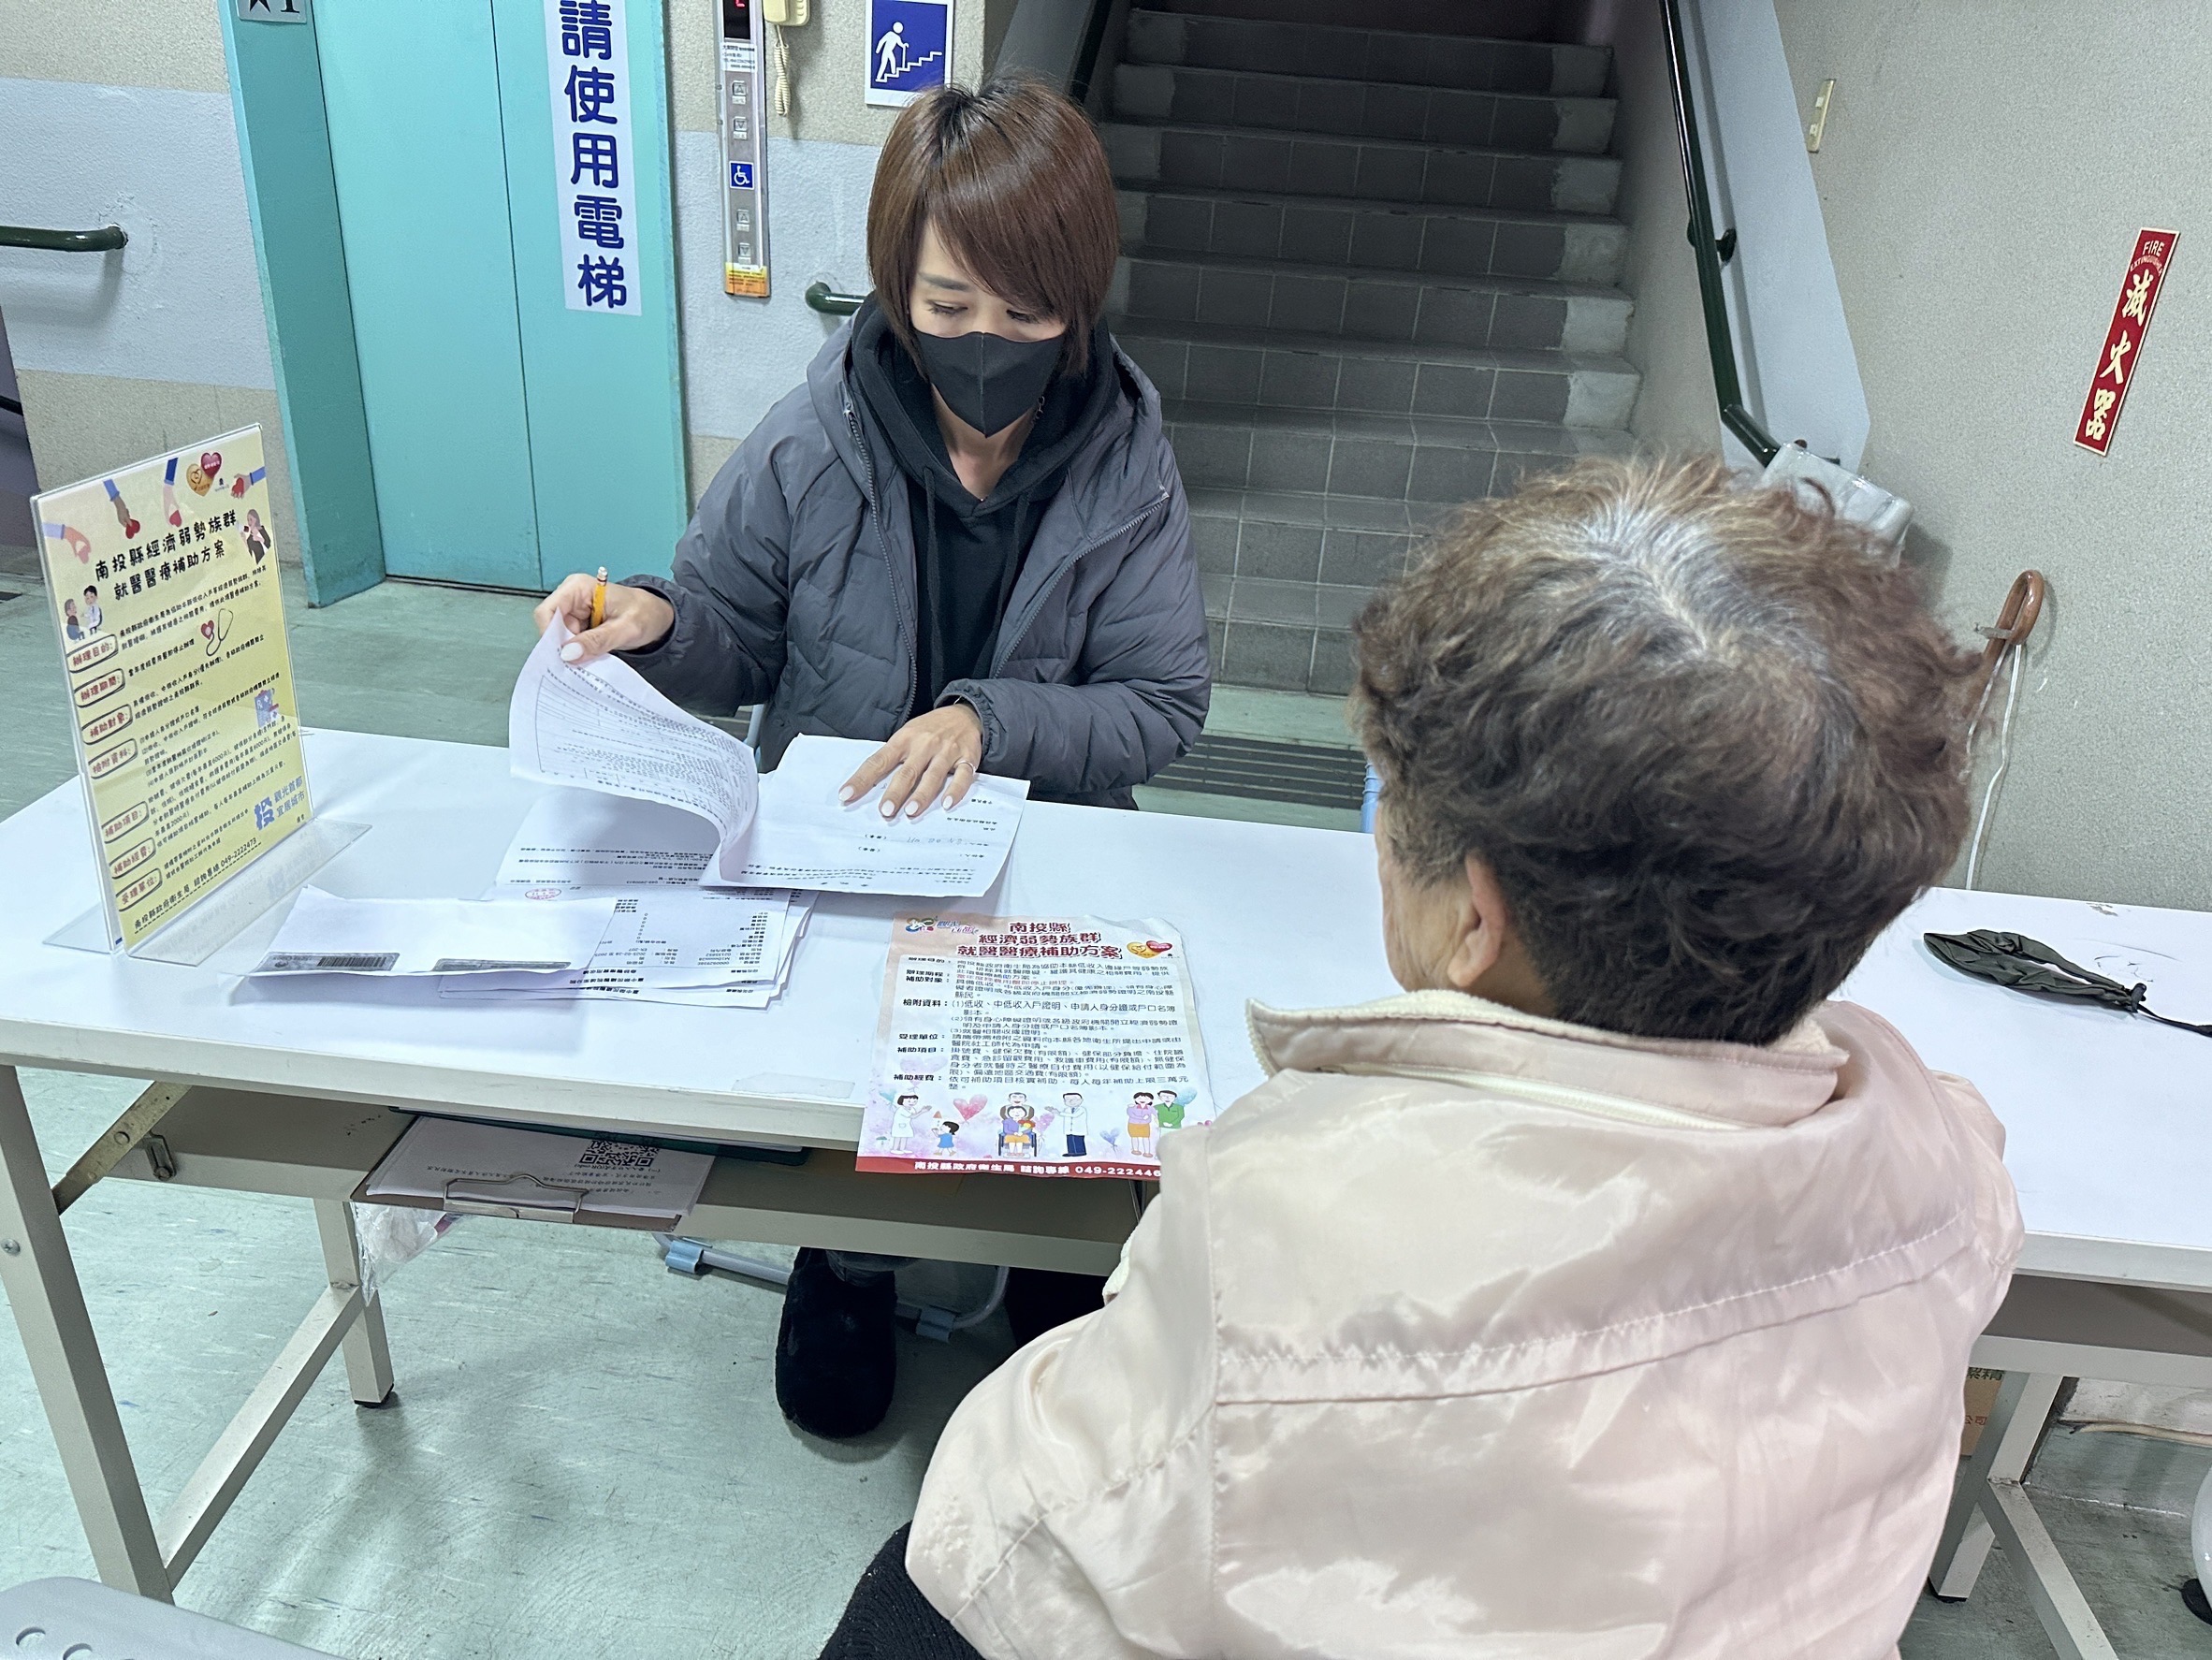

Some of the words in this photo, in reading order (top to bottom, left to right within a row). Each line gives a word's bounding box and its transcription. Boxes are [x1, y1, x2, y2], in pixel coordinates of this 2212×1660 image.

[559, 0, 628, 309] 請使用電梯
[2141, 240, 2165, 257] FIRE
[2085, 269, 2154, 442] 滅火器
[94, 508, 238, 583] 南投縣經濟弱勢族群
[112, 539, 226, 603] 就醫醫療補助方案
[273, 774, 303, 804] 觀光首都
[276, 789, 305, 818] 宜居城市
[220, 836, 257, 868] 049-2222473
[978, 932, 1101, 946] 經濟弱勢族群
[1010, 922, 1071, 934] 南投縣
[956, 945, 1123, 960] 就醫醫療補助方案
[1075, 1166, 1161, 1177] 049-222446
